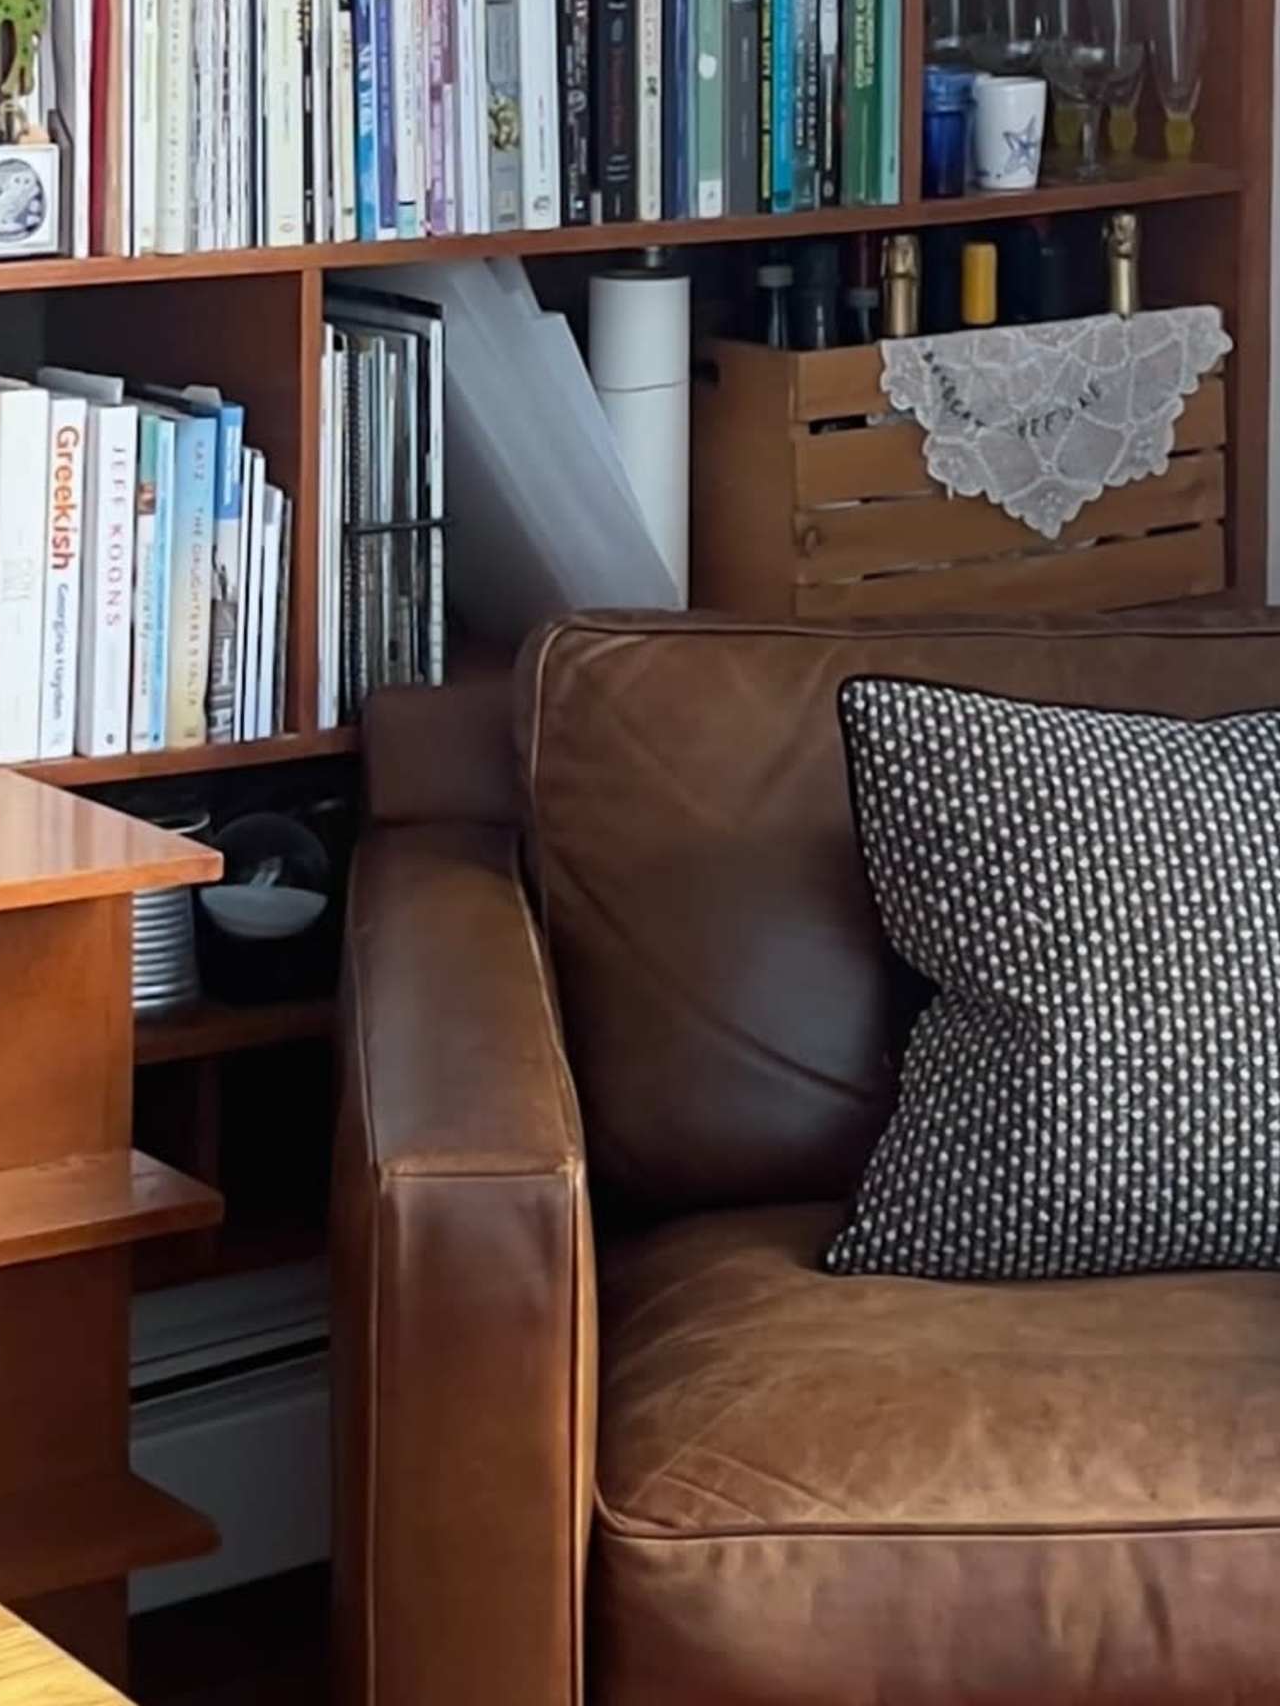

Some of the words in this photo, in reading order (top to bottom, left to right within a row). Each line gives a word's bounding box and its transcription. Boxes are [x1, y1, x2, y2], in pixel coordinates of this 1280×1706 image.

[51, 425, 80, 571] Greekish
[110, 445, 127, 508] JEFF
[193, 508, 204, 538] THE
[104, 522, 126, 629] KOONS
[188, 542, 203, 642] DAUGHTERS
[53, 583, 71, 654] Georgina
